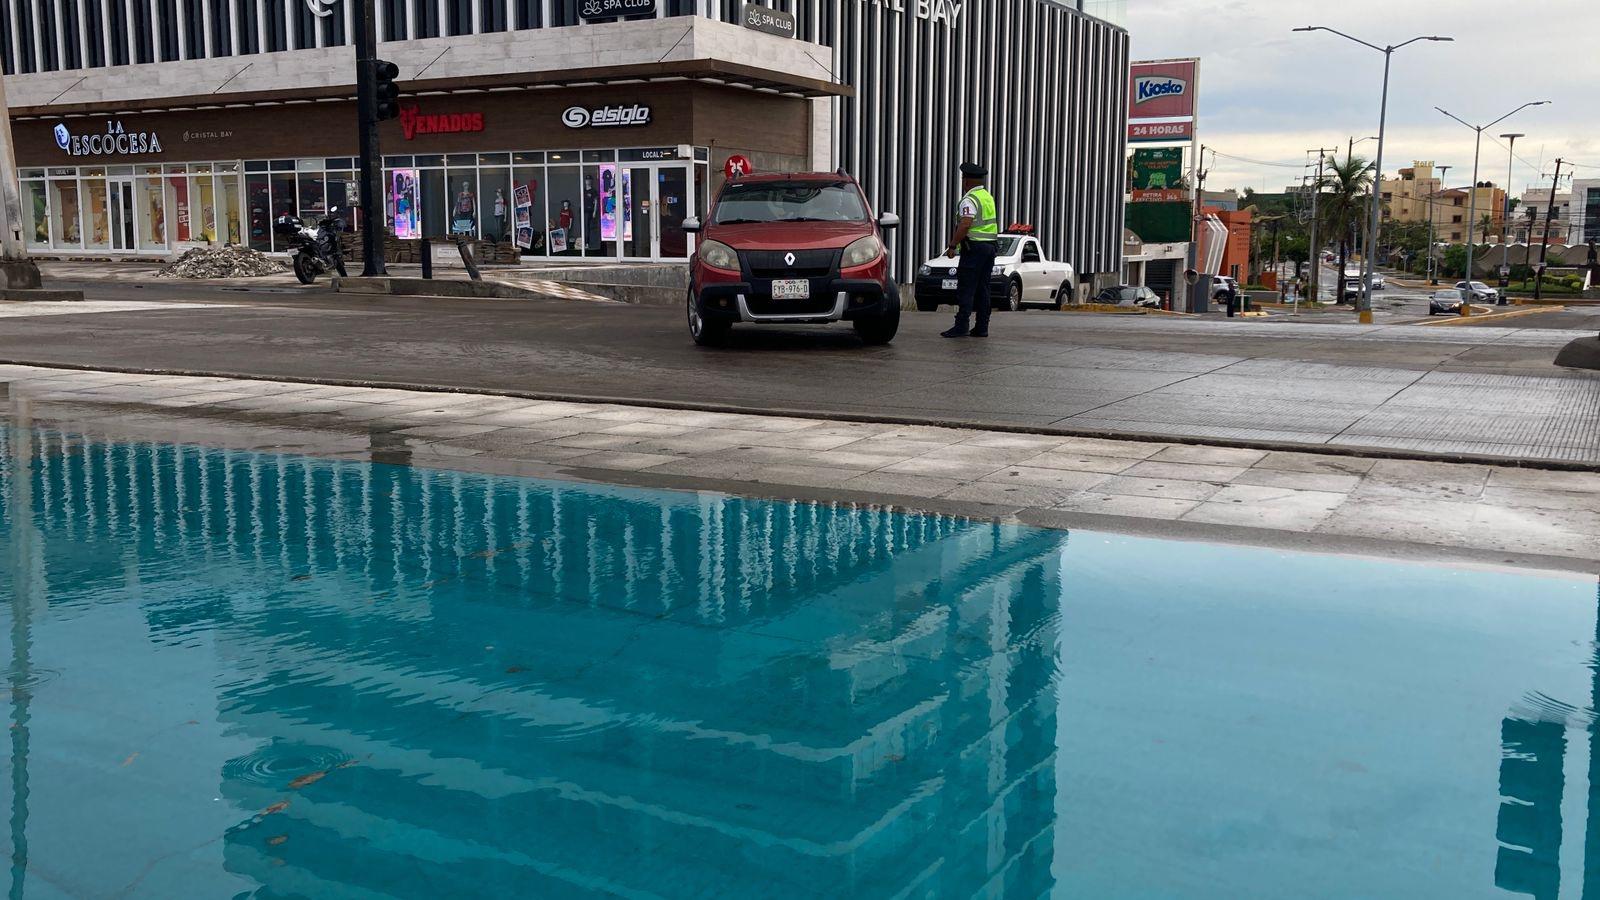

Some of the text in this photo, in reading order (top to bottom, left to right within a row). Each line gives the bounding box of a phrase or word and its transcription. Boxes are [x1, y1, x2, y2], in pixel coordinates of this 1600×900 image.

[603, 0, 651, 10] SPA CLUB
[762, 14, 792, 31] SPA CLUB
[917, 0, 962, 29] BAY
[1138, 80, 1182, 99] Kiosko
[401, 104, 483, 139] VENADOS
[591, 104, 649, 125] elsiglo
[107, 120, 125, 133] LA
[1133, 125, 1184, 136] 24 HORAS
[73, 132, 161, 156] ESCOCESA
[642, 151, 660, 159] LOCAL
